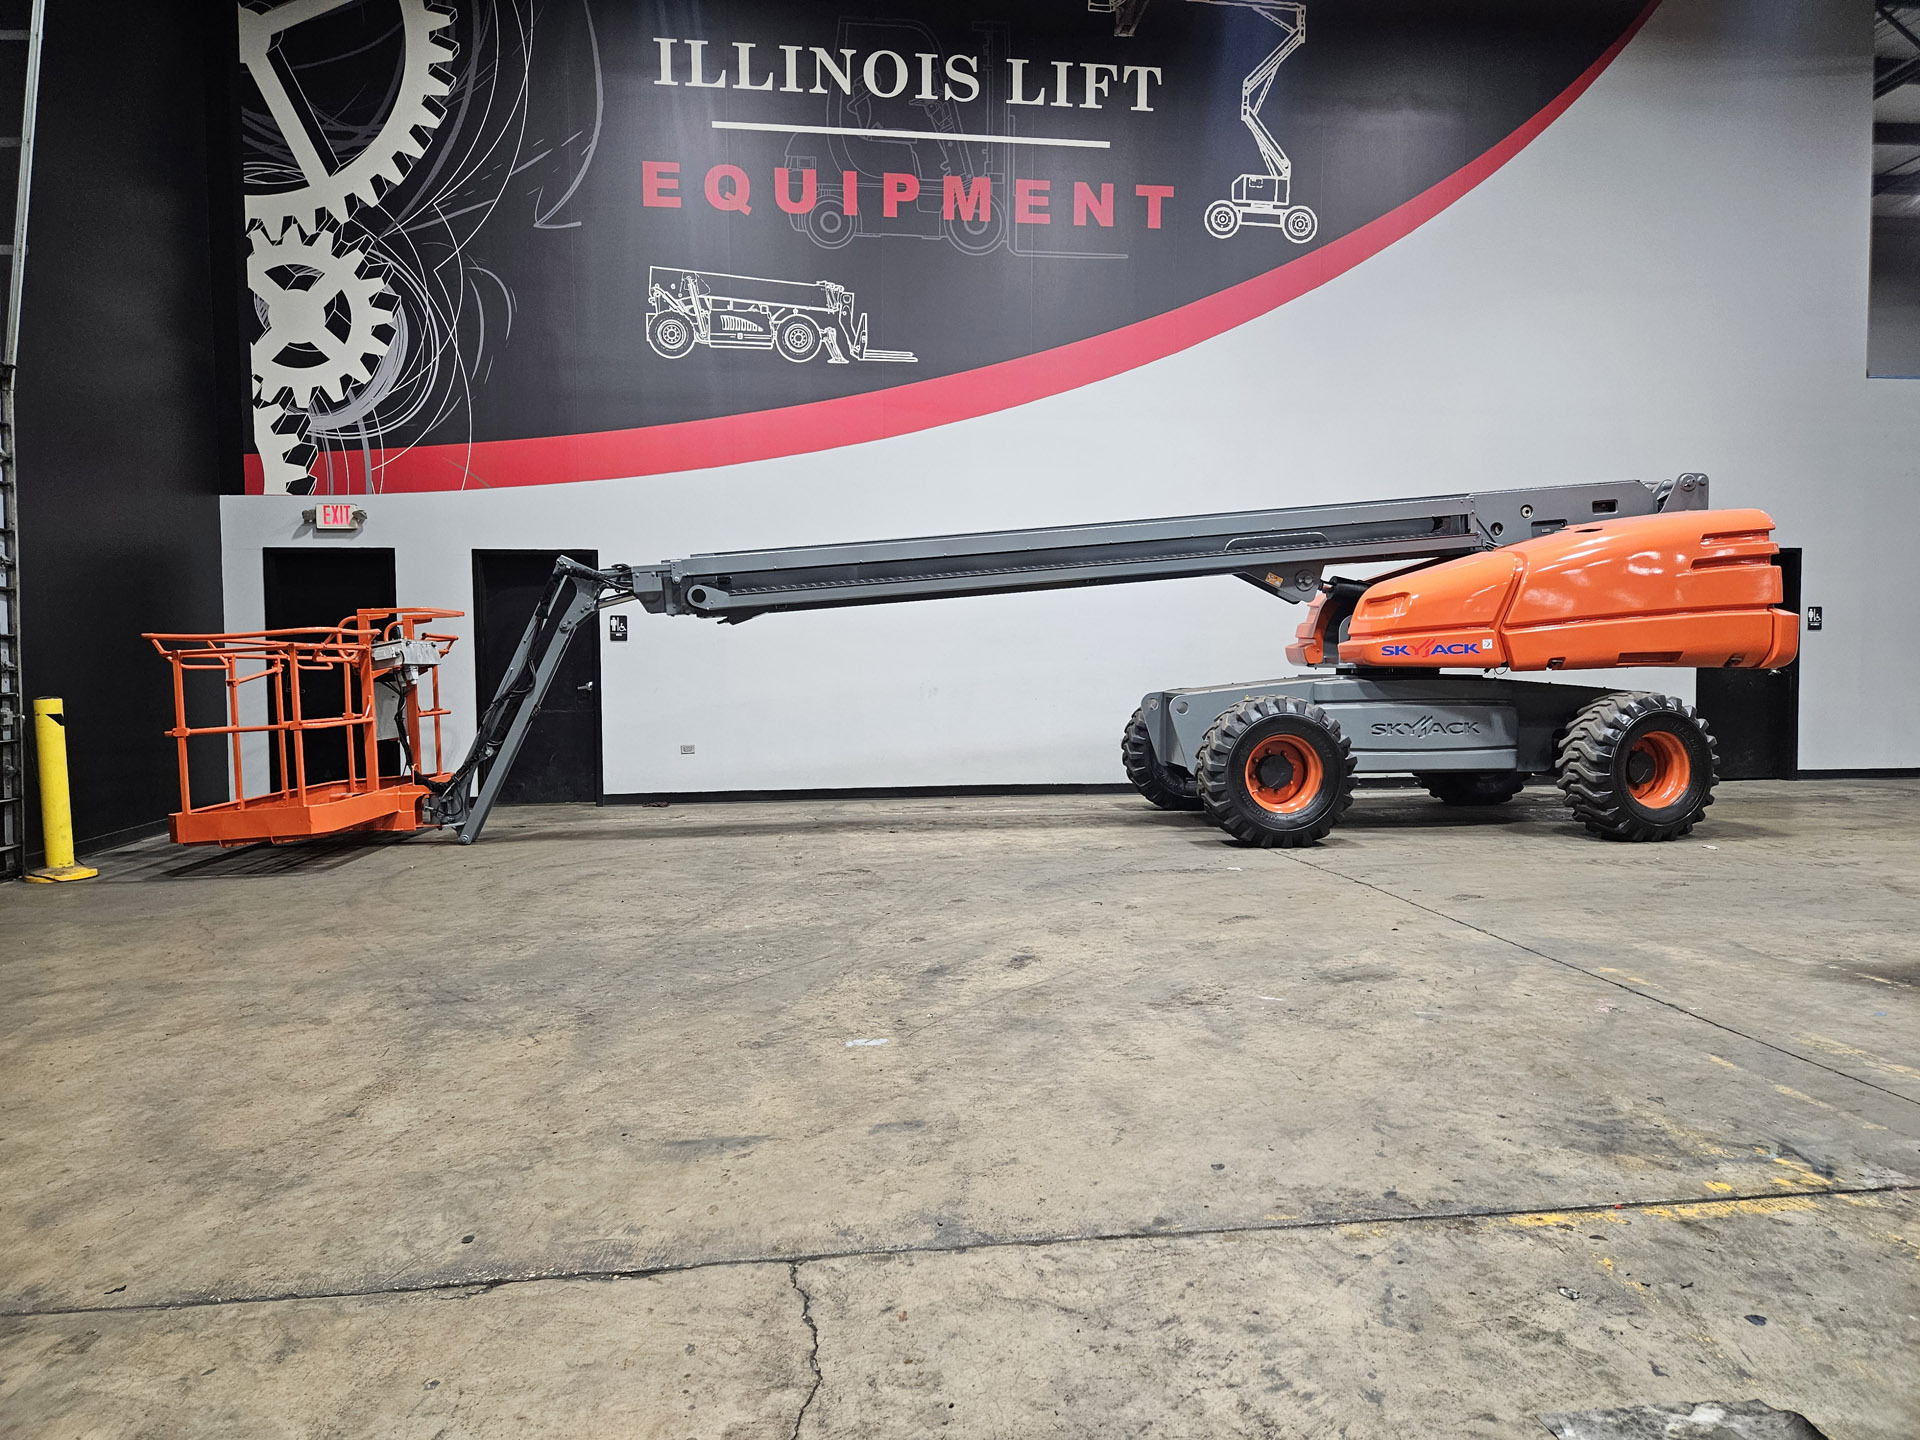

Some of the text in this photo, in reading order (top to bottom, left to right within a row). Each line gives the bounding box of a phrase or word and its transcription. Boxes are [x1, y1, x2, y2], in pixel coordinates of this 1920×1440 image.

[652, 37, 1163, 112] ILLINOIS LIFT
[641, 160, 1176, 230] EQUIPMENT
[323, 505, 351, 525] EXIT
[1381, 638, 1481, 659] SKYJACK
[1371, 715, 1481, 739] SKYJACK
